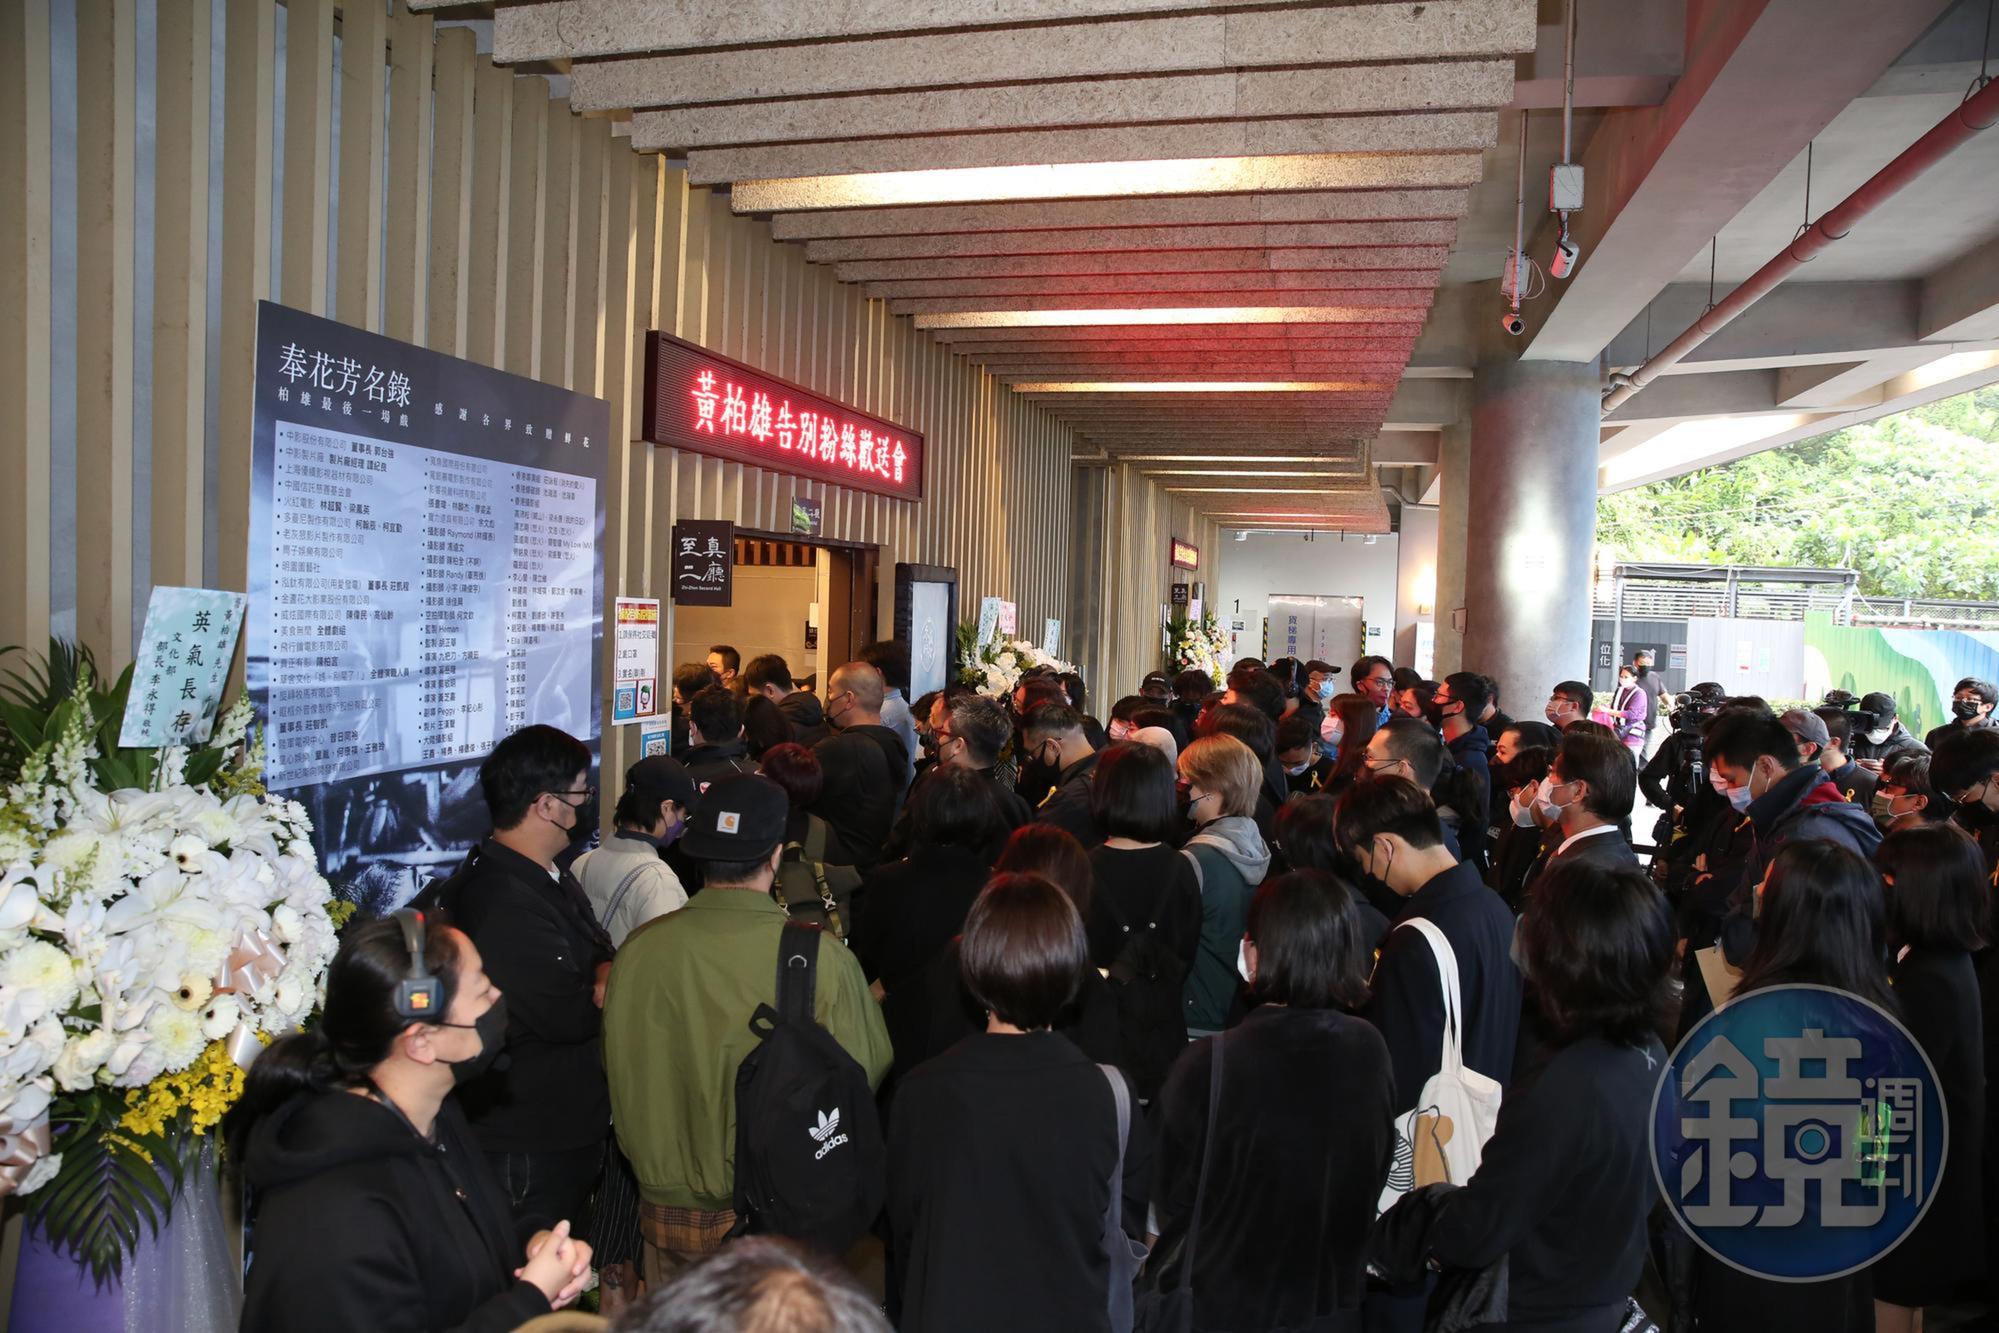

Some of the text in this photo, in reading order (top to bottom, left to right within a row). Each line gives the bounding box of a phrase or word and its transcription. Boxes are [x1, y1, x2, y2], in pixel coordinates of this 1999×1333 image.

[278, 342, 411, 408] 奉花芳名錄
[692, 370, 907, 484] 黃柏雄告別粉絲歡送會
[165, 631, 183, 677] 文化部
[170, 610, 212, 734] 英氣長存
[815, 1133, 848, 1160] adidas
